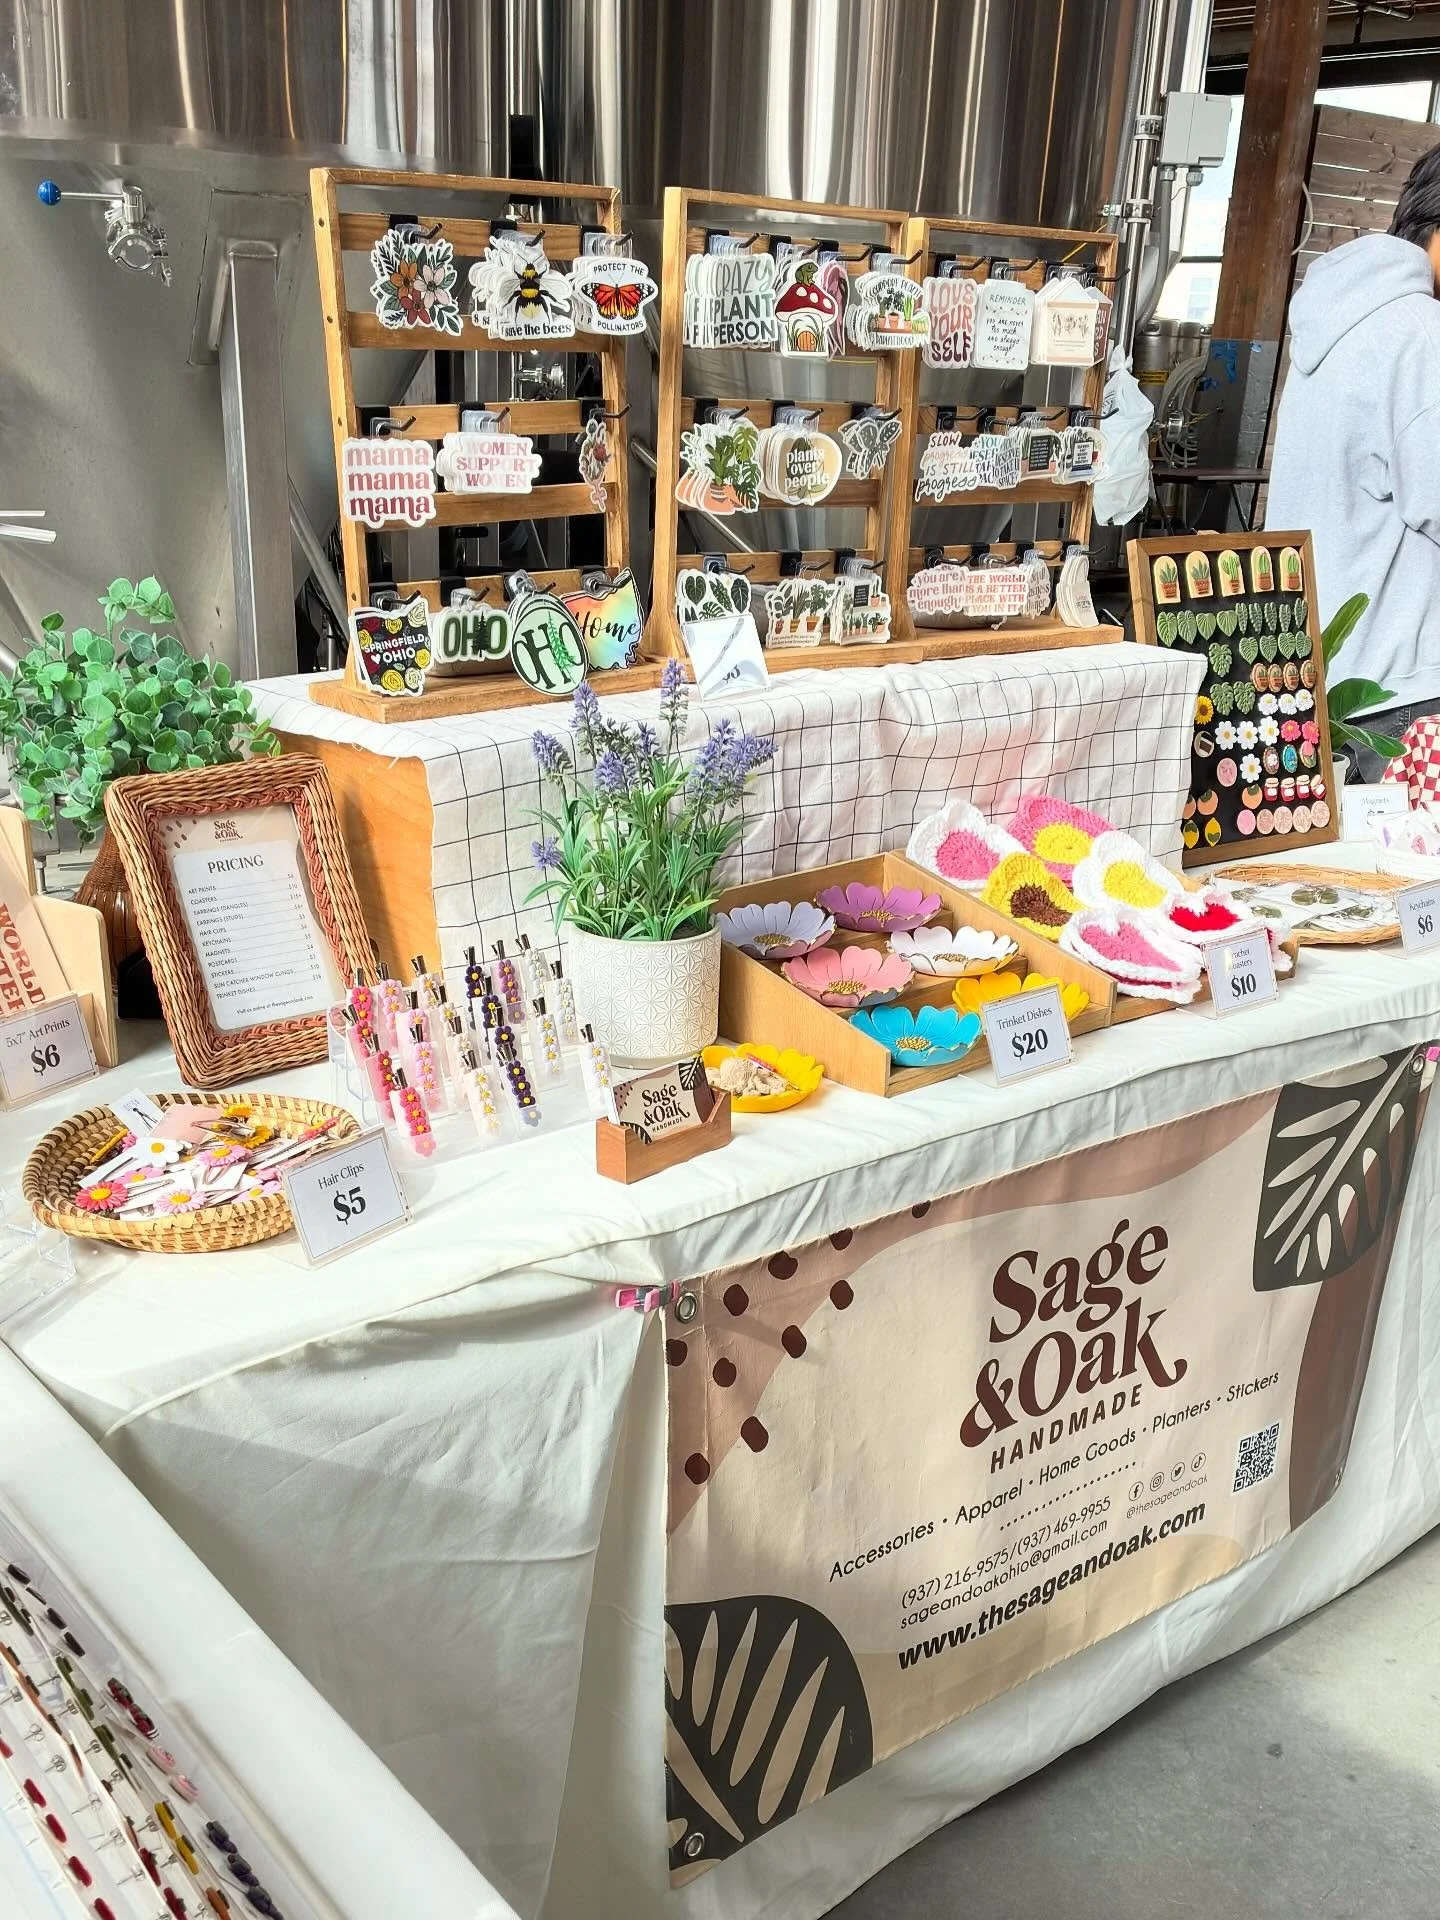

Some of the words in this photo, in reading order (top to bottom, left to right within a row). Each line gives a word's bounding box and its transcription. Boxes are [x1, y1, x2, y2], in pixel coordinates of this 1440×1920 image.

[593, 263, 627, 276] PROTECT
[629, 264, 645, 276] THE
[716, 258, 773, 297] CRAZY
[930, 283, 974, 311] LOVE
[990, 294, 1026, 306] REMINDER
[714, 294, 773, 323] PLANT
[505, 326, 523, 336] save
[524, 324, 541, 335] the
[543, 322, 572, 334] bees
[597, 320, 644, 331] POLLINATORS
[930, 305, 973, 340] YOUR
[714, 320, 776, 345] PERSON
[931, 331, 971, 362] SELF
[467, 441, 527, 456] WOMEN
[931, 434, 960, 447] SLOW
[347, 444, 429, 466] mama
[787, 447, 824, 465] plants
[456, 457, 536, 472] SUPPORT
[790, 461, 817, 474] over
[926, 464, 938, 476] IS
[943, 462, 976, 475] STILL
[348, 469, 430, 492] mama
[466, 473, 527, 488] WOEN
[784, 472, 830, 490] people
[916, 476, 977, 499] progress
[350, 494, 431, 522] mama
[918, 571, 938, 585] you
[939, 571, 959, 582] are
[968, 575, 985, 583] THE
[990, 574, 1025, 583] WORLD
[909, 587, 939, 600] more
[942, 583, 964, 595] than
[976, 585, 983, 593] A
[986, 584, 1026, 593] BETTER
[918, 596, 959, 612] enough
[965, 594, 996, 603] PLACE
[999, 594, 1024, 603] WITH
[972, 604, 992, 613] YOU
[1008, 604, 1017, 612] IT
[364, 633, 424, 653] SPRINGFIELD
[382, 647, 416, 663] OHIO
[214, 820, 236, 831] Sage
[215, 828, 243, 839] &Oak
[207, 854, 264, 874] PRICING
[190, 896, 217, 905] COASTERS
[193, 907, 220, 916] EARRINGS
[197, 917, 223, 926] EARRINGS
[1418, 914, 1433, 937] $6
[200, 929, 211, 937] HAIR
[212, 927, 226, 935] CLIPS
[202, 938, 231, 947] KEYCHAINS
[205, 948, 231, 957] MAGNETS
[1229, 948, 1251, 961] rochet
[208, 958, 238, 968] POSTCARDS
[1229, 958, 1253, 971] oasters
[211, 970, 234, 978] STICKERS
[214, 981, 225, 989] SUN
[226, 977, 249, 987] CATCHER
[250, 973, 273, 982] WINDOW
[216, 991, 237, 999] TRINKET
[238, 986, 256, 995] DISHES
[1231, 973, 1257, 1001] $10
[996, 1012, 1026, 1030] Trinket
[1026, 1007, 1053, 1021] Dishes
[29, 1025, 44, 1040] Art
[44, 1017, 71, 1034] Prints
[1011, 1028, 1048, 1061] $20
[30, 1044, 61, 1076] $6
[641, 1083, 677, 1108] Sage
[643, 1101, 690, 1127] &Oak
[652, 1117, 683, 1133] HANDMADE
[317, 1172, 339, 1191] Hair
[339, 1162, 365, 1184] Clips
[333, 1186, 367, 1225] $5
[989, 1218, 1169, 1343] Sage
[960, 1297, 1188, 1448] &Oak
[990, 1383, 1142, 1474] HANDMADE
[830, 1521, 935, 1583] Accessories
[955, 1479, 1023, 1525] Apparel
[1039, 1453, 1080, 1486] Home
[1085, 1428, 1136, 1461] Goods
[1152, 1399, 1211, 1433] Planters
[1226, 1371, 1279, 1402] Stickers
[1126, 1473, 1208, 1519] @thesageandoak
[901, 1577, 941, 1609] (937)
[1054, 1496, 1111, 1535] 469-9955
[901, 1519, 1108, 1629] sageandoakohio@gmail.com
[898, 1503, 1206, 1670] www.thesageandoak.com
